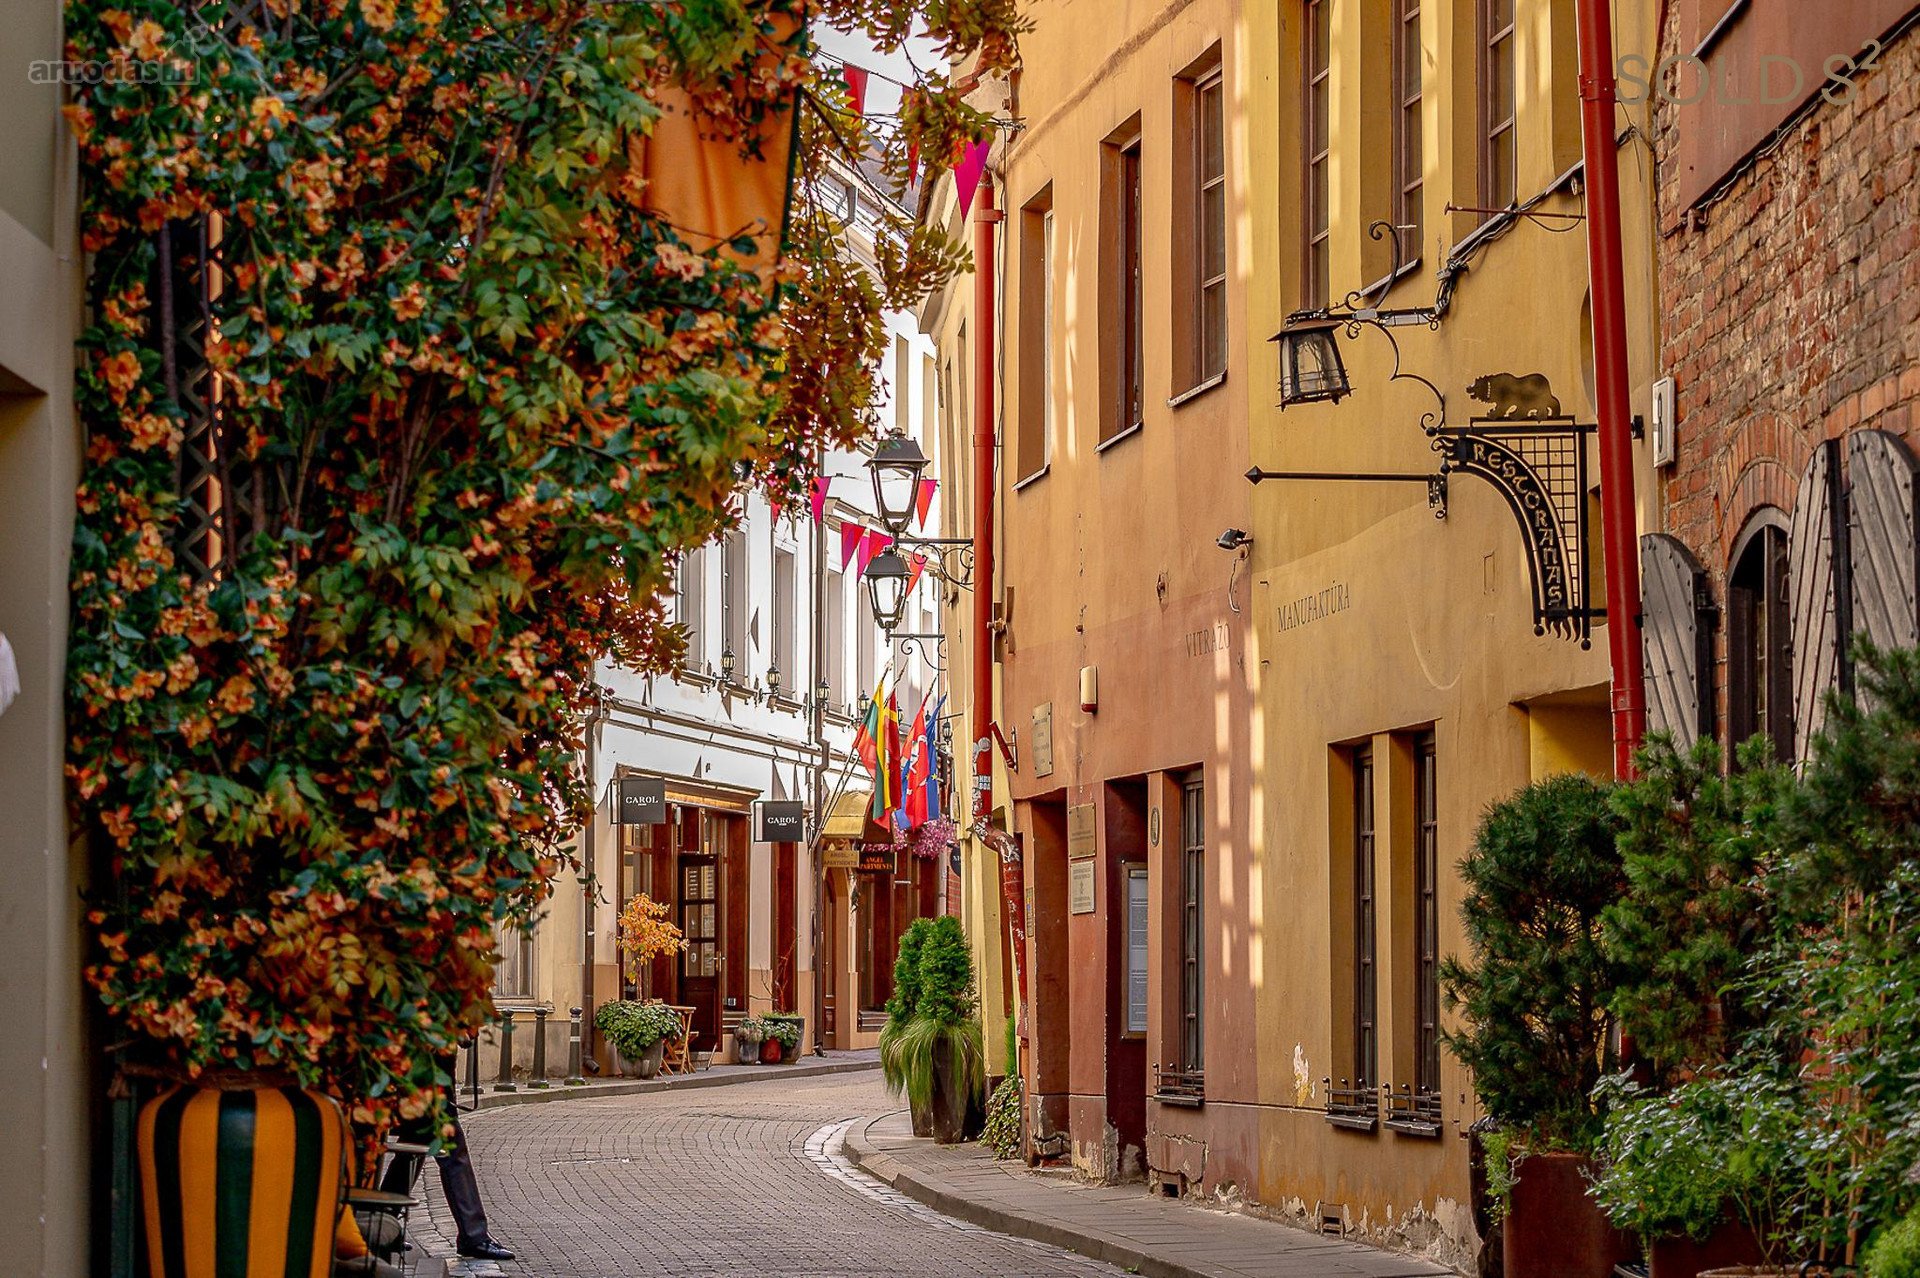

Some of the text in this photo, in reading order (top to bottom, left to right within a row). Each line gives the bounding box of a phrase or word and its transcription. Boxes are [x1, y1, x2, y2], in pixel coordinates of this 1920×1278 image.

[1473, 443, 1563, 606] RESTORANAS
[625, 795, 659, 804] CAROL
[767, 816, 798, 825] CAROL
